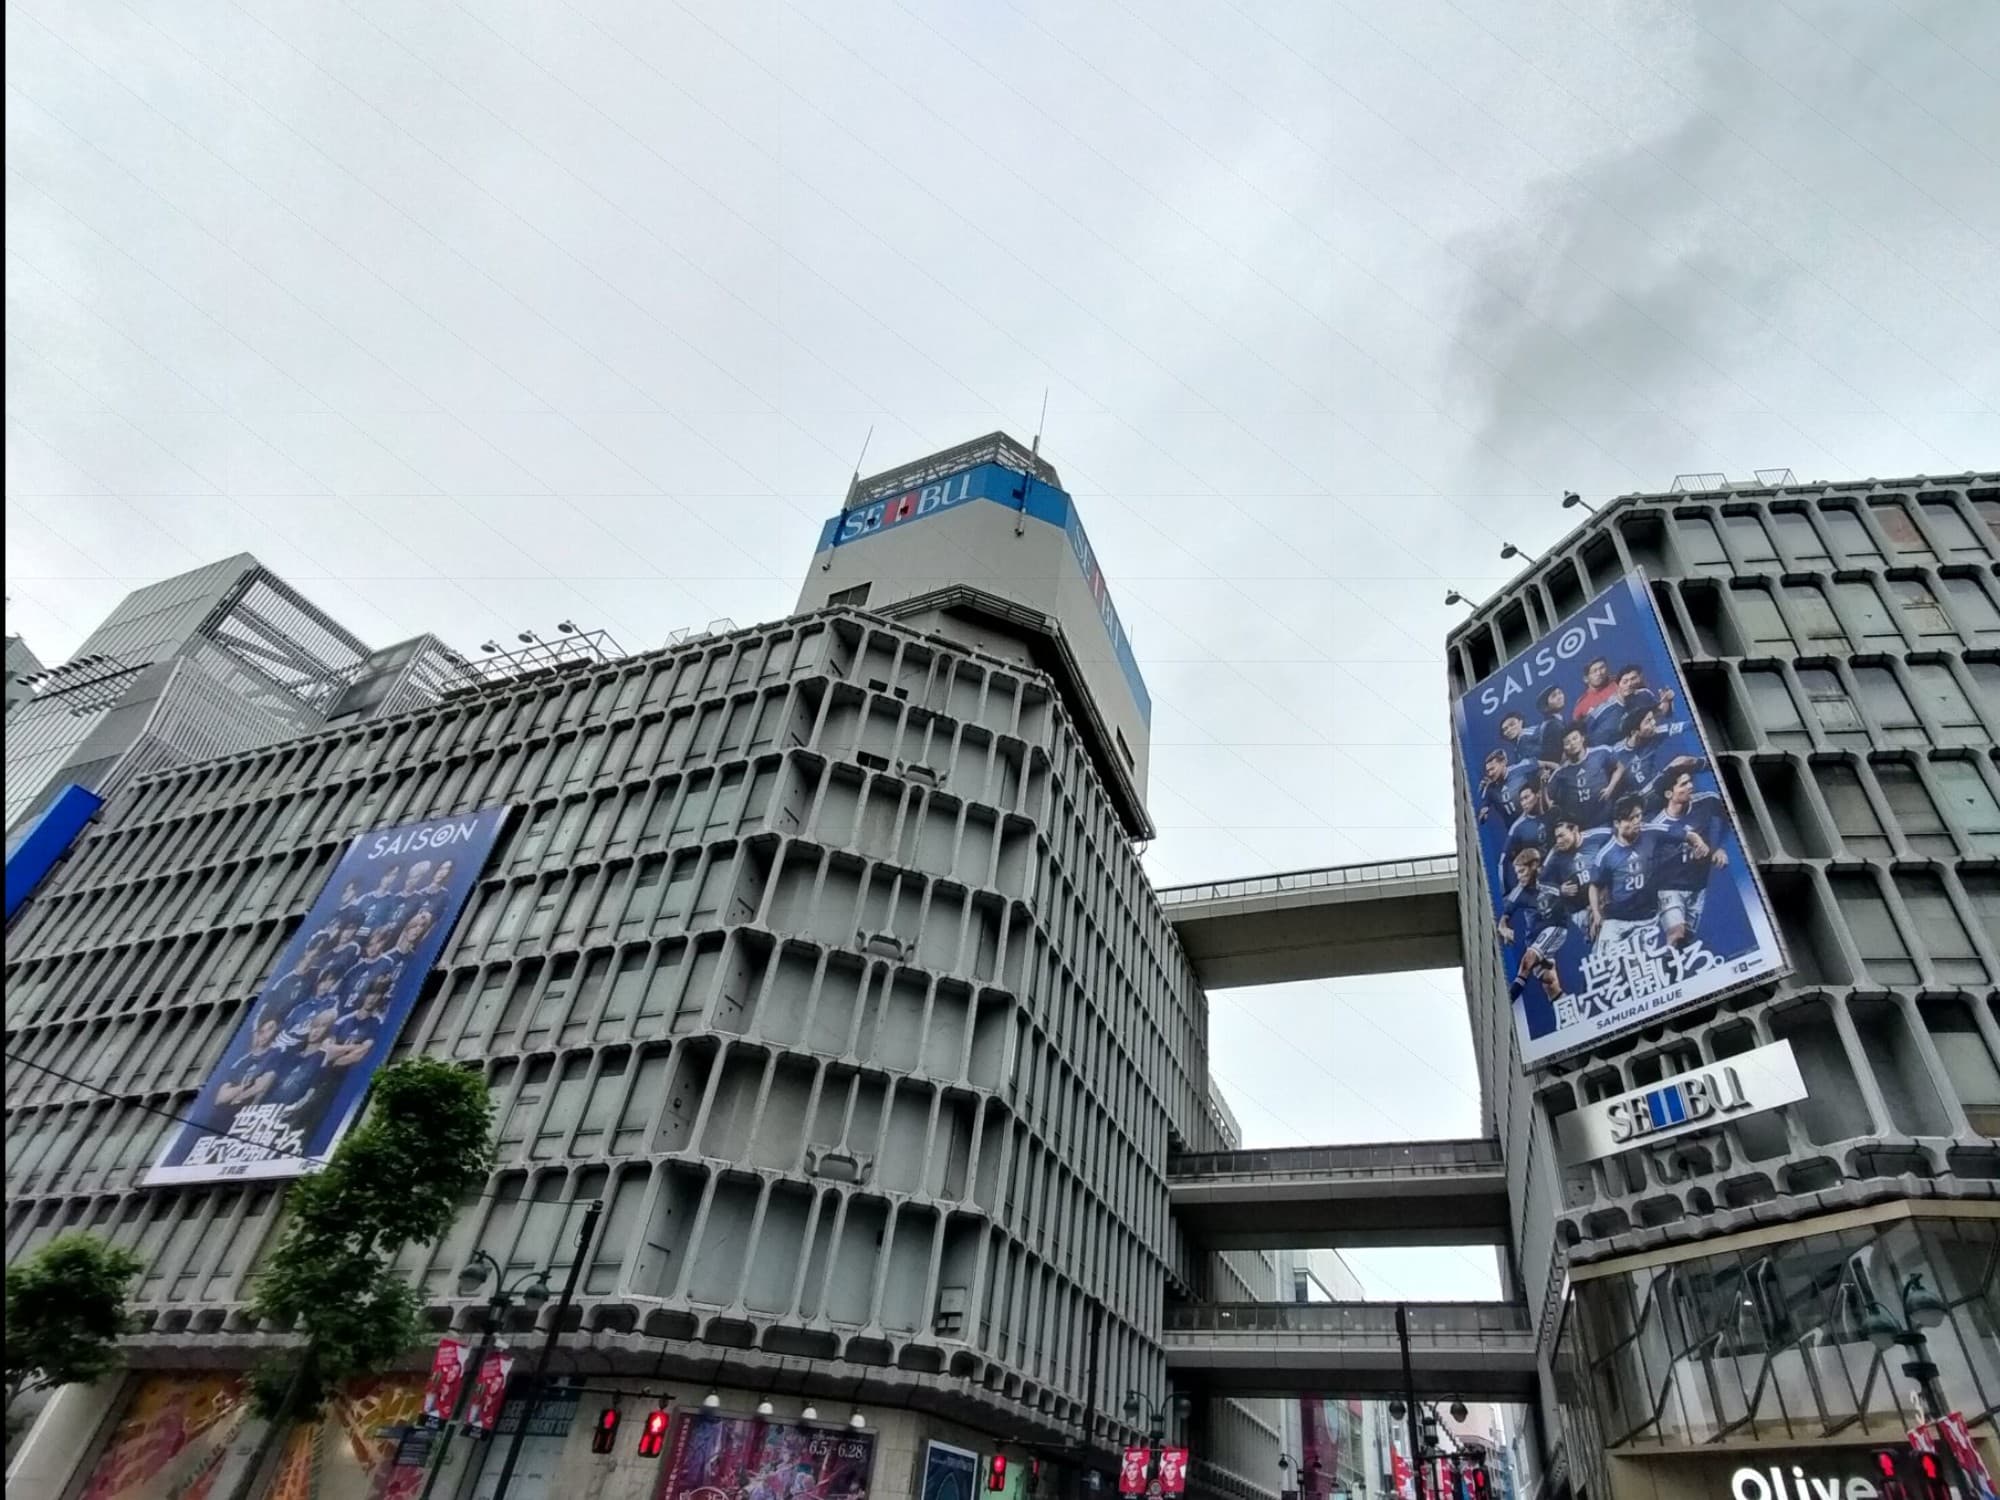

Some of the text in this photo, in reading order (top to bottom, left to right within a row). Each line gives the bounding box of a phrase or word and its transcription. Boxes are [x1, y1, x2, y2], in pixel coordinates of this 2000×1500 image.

[841, 474, 970, 541] SEIBU
[1481, 602, 1617, 715] SAISON
[367, 819, 479, 859] SAISON
[1625, 872, 1644, 891] 20
[1579, 925, 1661, 989] 世界に
[1596, 988, 1682, 1030] SAMURAI BLUE
[1607, 1066, 1751, 1144] SEIBU
